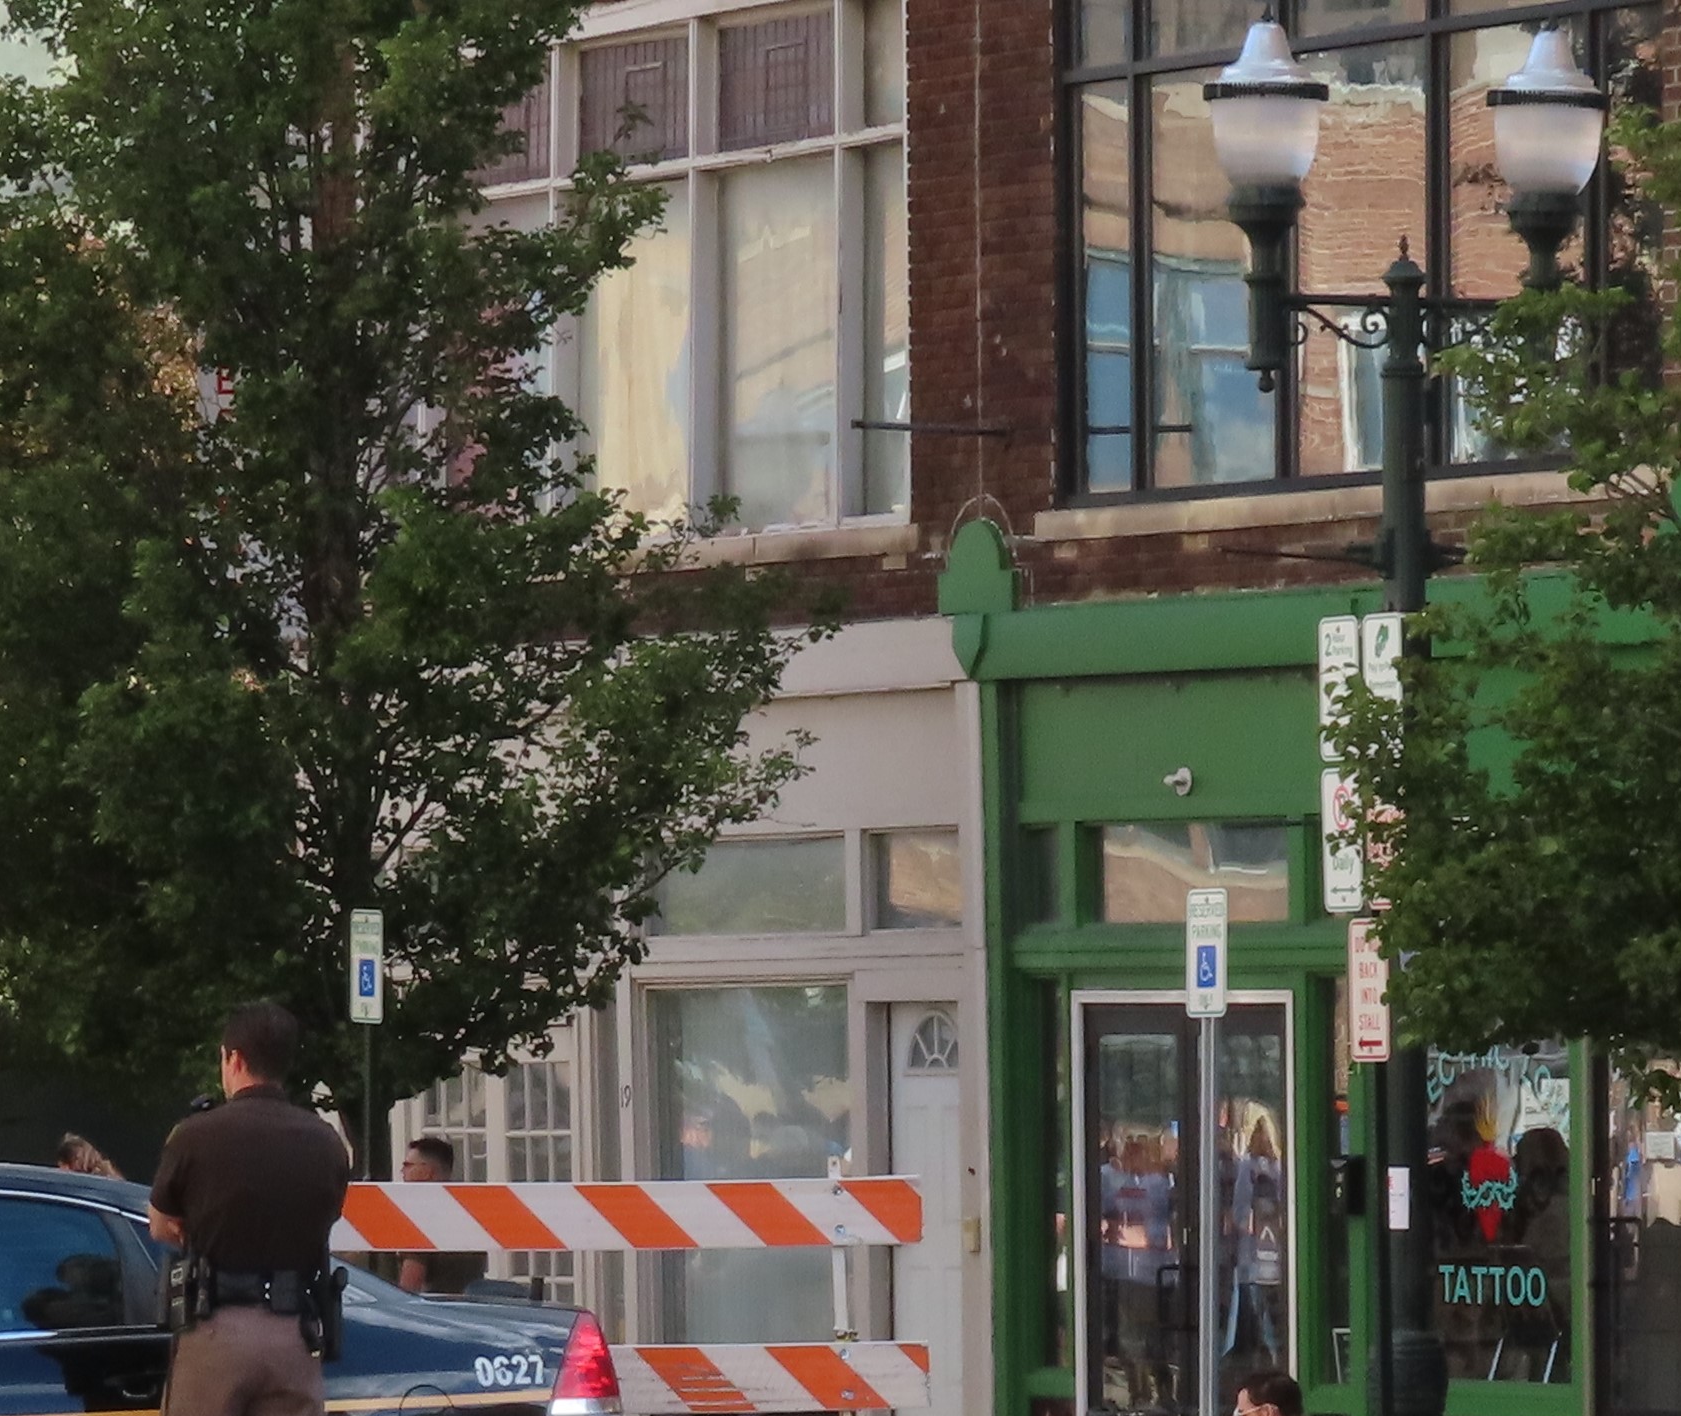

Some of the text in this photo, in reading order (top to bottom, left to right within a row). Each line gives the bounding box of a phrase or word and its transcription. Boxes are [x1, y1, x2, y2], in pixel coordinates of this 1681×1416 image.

[1359, 1013, 1380, 1031] STALL
[1439, 1264, 1546, 1307] TATTOO
[474, 1354, 544, 1387] 0627
